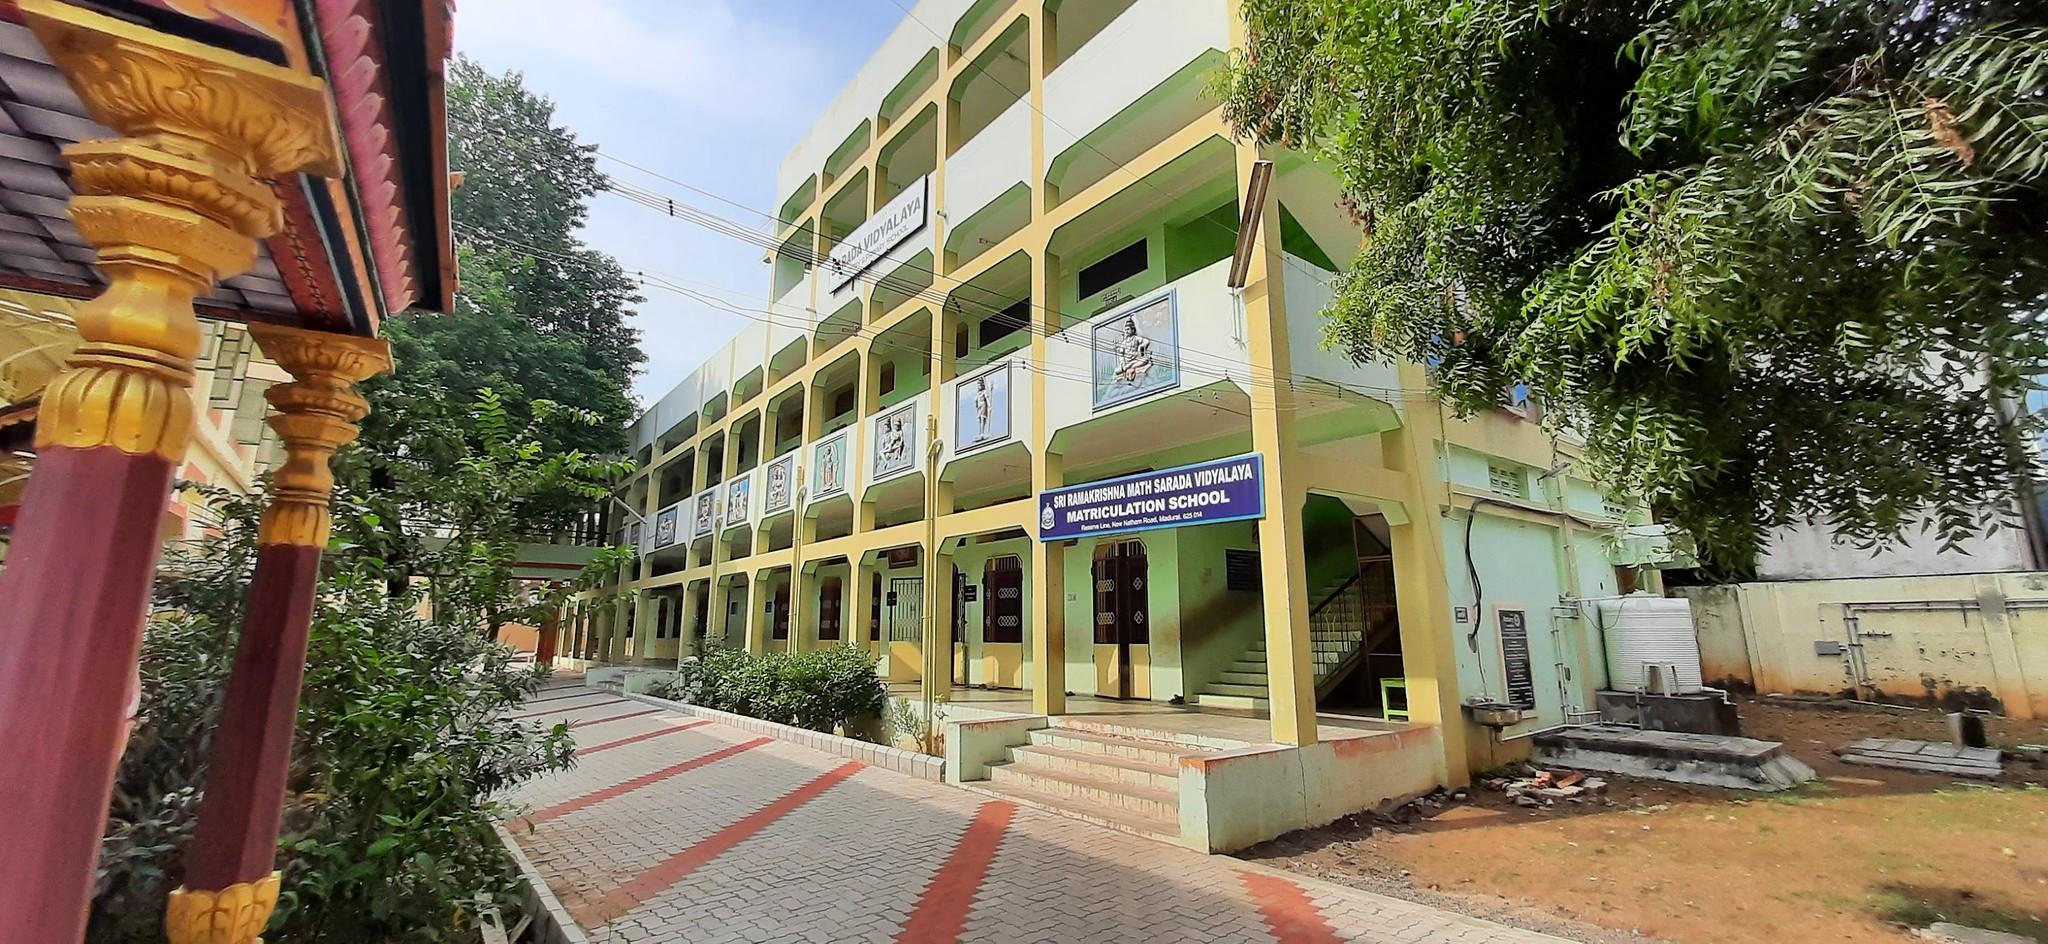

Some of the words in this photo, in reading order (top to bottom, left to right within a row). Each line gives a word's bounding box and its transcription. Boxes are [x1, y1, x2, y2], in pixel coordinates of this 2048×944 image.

[863, 196, 920, 250] VIDYALAYA
[1054, 494, 1066, 509] SRI
[1067, 484, 1126, 507] RAMAKRISHNA
[1127, 479, 1152, 498] MATH
[1154, 473, 1193, 494] SARADA
[1194, 463, 1253, 487] VIDYALAYA
[1066, 498, 1166, 523] MATRICULATION
[1169, 489, 1230, 511] SCHOOL
[1143, 516, 1159, 524] Road,
[1183, 512, 1193, 520] 625
[1193, 511, 1203, 519] 014
